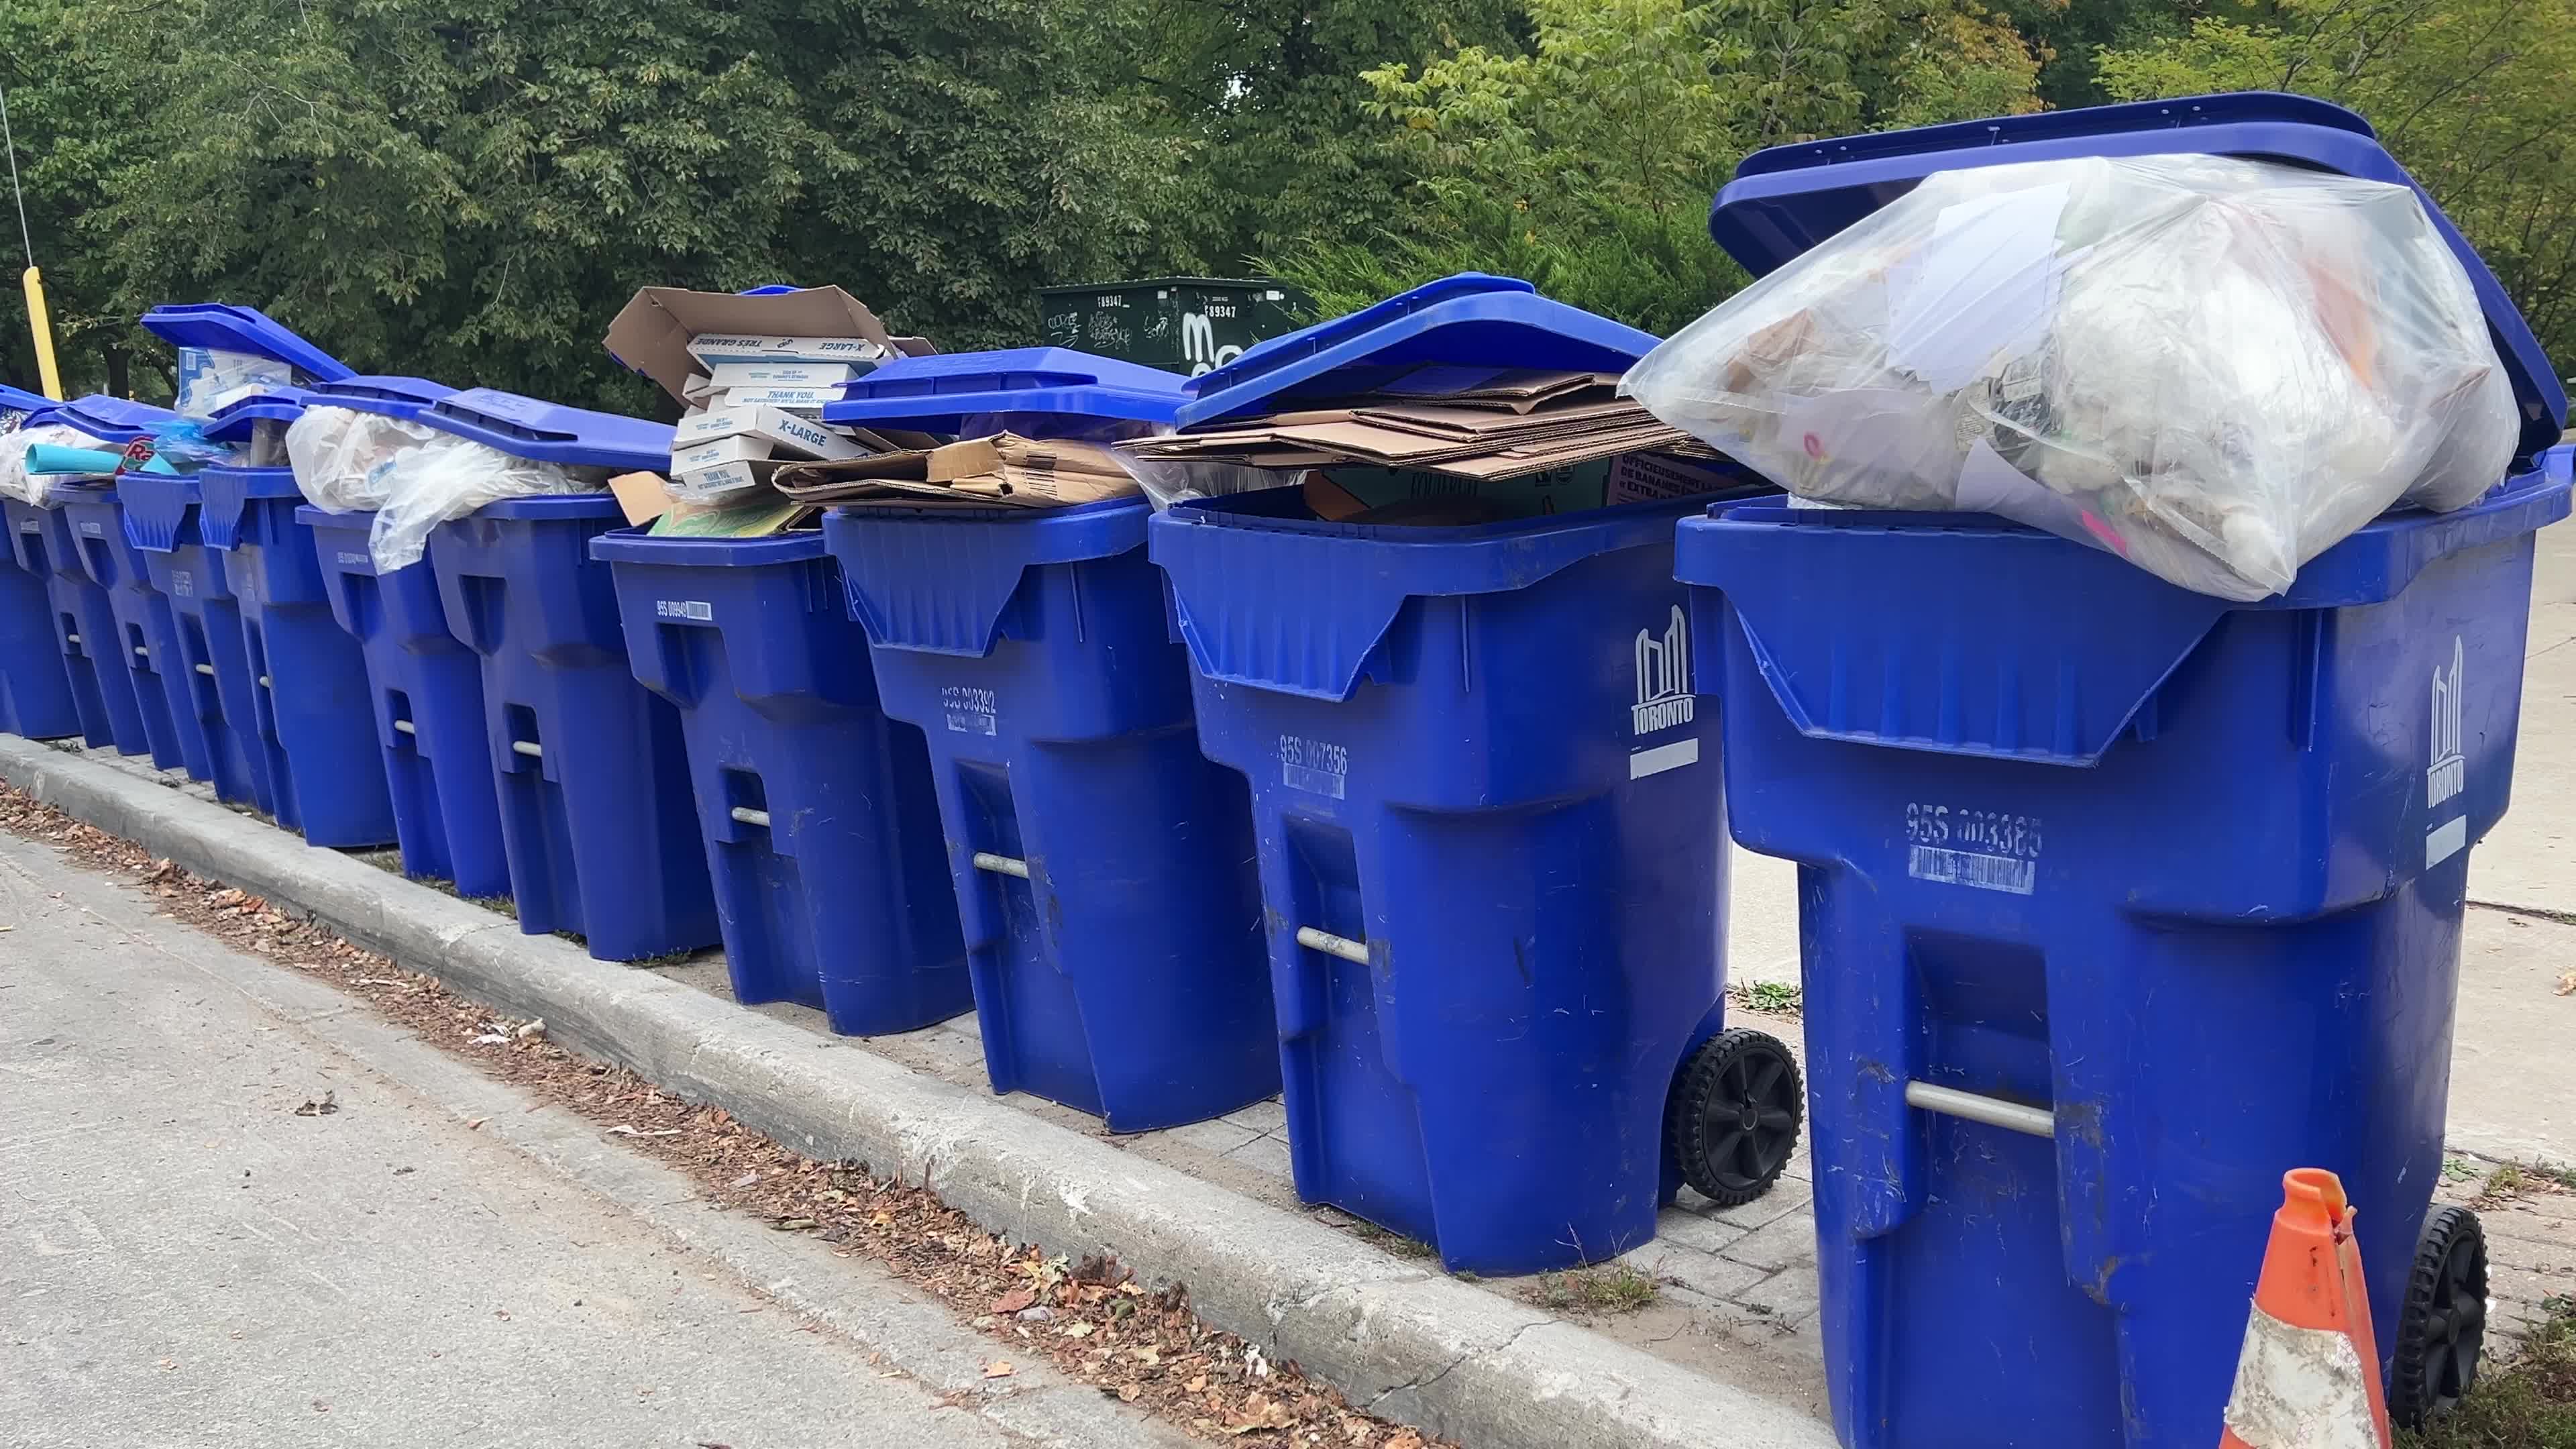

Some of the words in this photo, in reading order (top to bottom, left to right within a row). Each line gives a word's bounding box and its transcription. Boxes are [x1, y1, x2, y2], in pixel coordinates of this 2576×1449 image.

[819, 342, 866, 352] X-LARGE
[779, 419, 826, 447] X-LARGE
[1631, 696, 1695, 735] TORONTO
[1280, 735, 1302, 765] 95S
[1306, 739, 1348, 775] 007356
[2427, 759, 2464, 809] TORONTO
[1906, 802, 1949, 844] 95S
